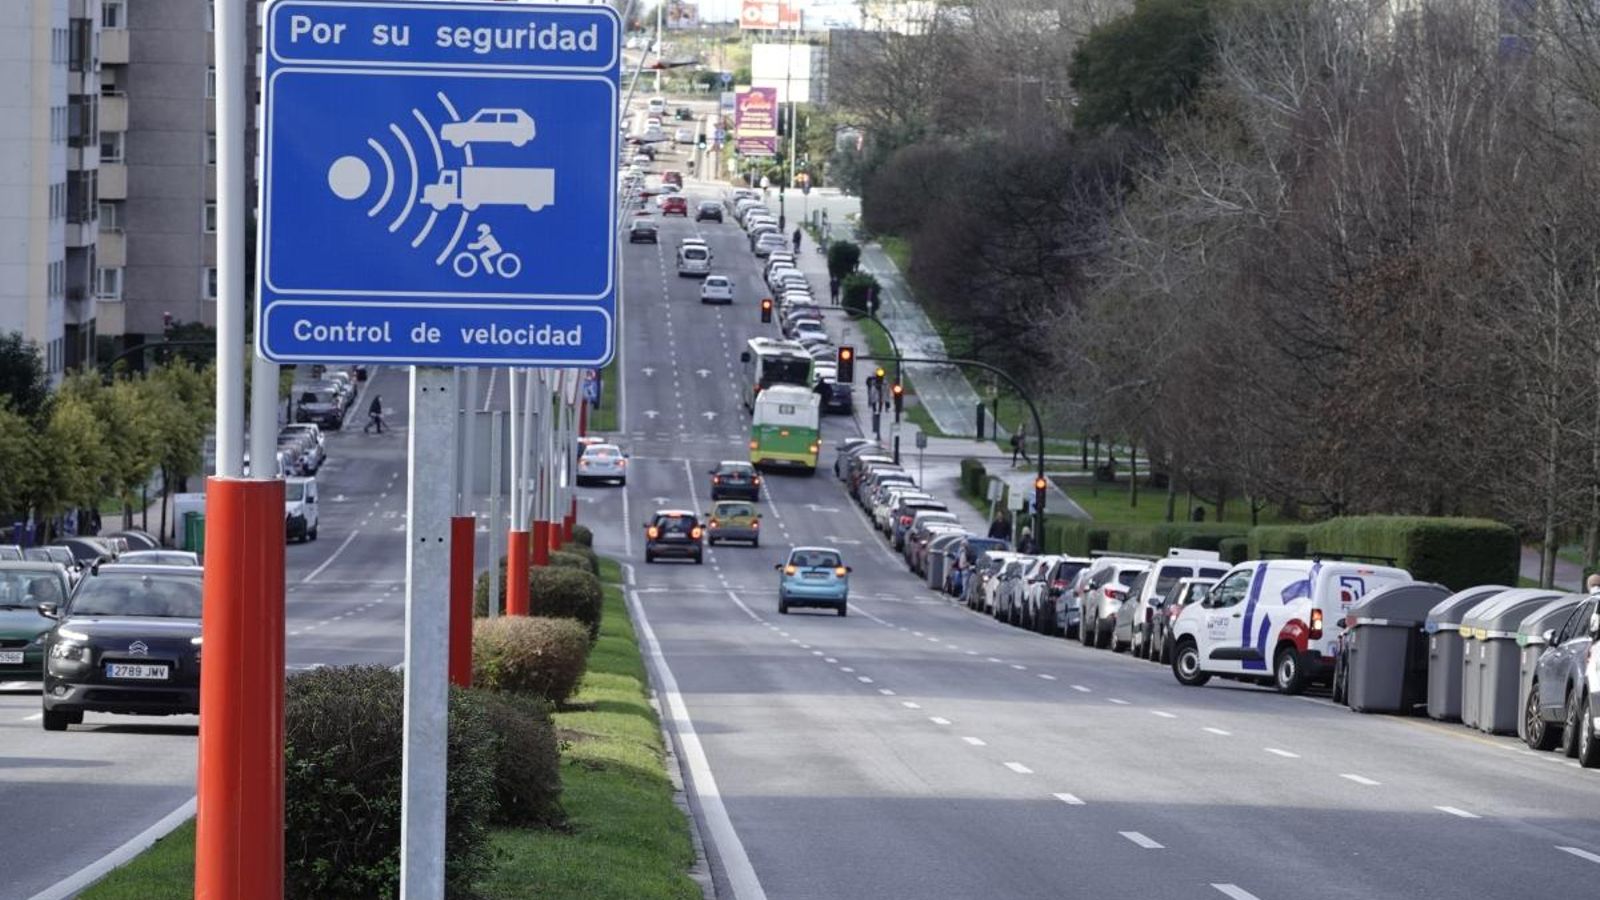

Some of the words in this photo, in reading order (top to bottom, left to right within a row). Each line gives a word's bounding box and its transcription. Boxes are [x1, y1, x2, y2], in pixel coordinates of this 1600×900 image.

[290, 15, 346, 45] Por
[372, 24, 410, 47] su
[435, 22, 599, 54] seguridad
[293, 319, 392, 343] Control
[410, 322, 442, 343] de
[460, 323, 582, 346] velocidad
[115, 666, 142, 676] 2789
[145, 667, 165, 677] JMV
